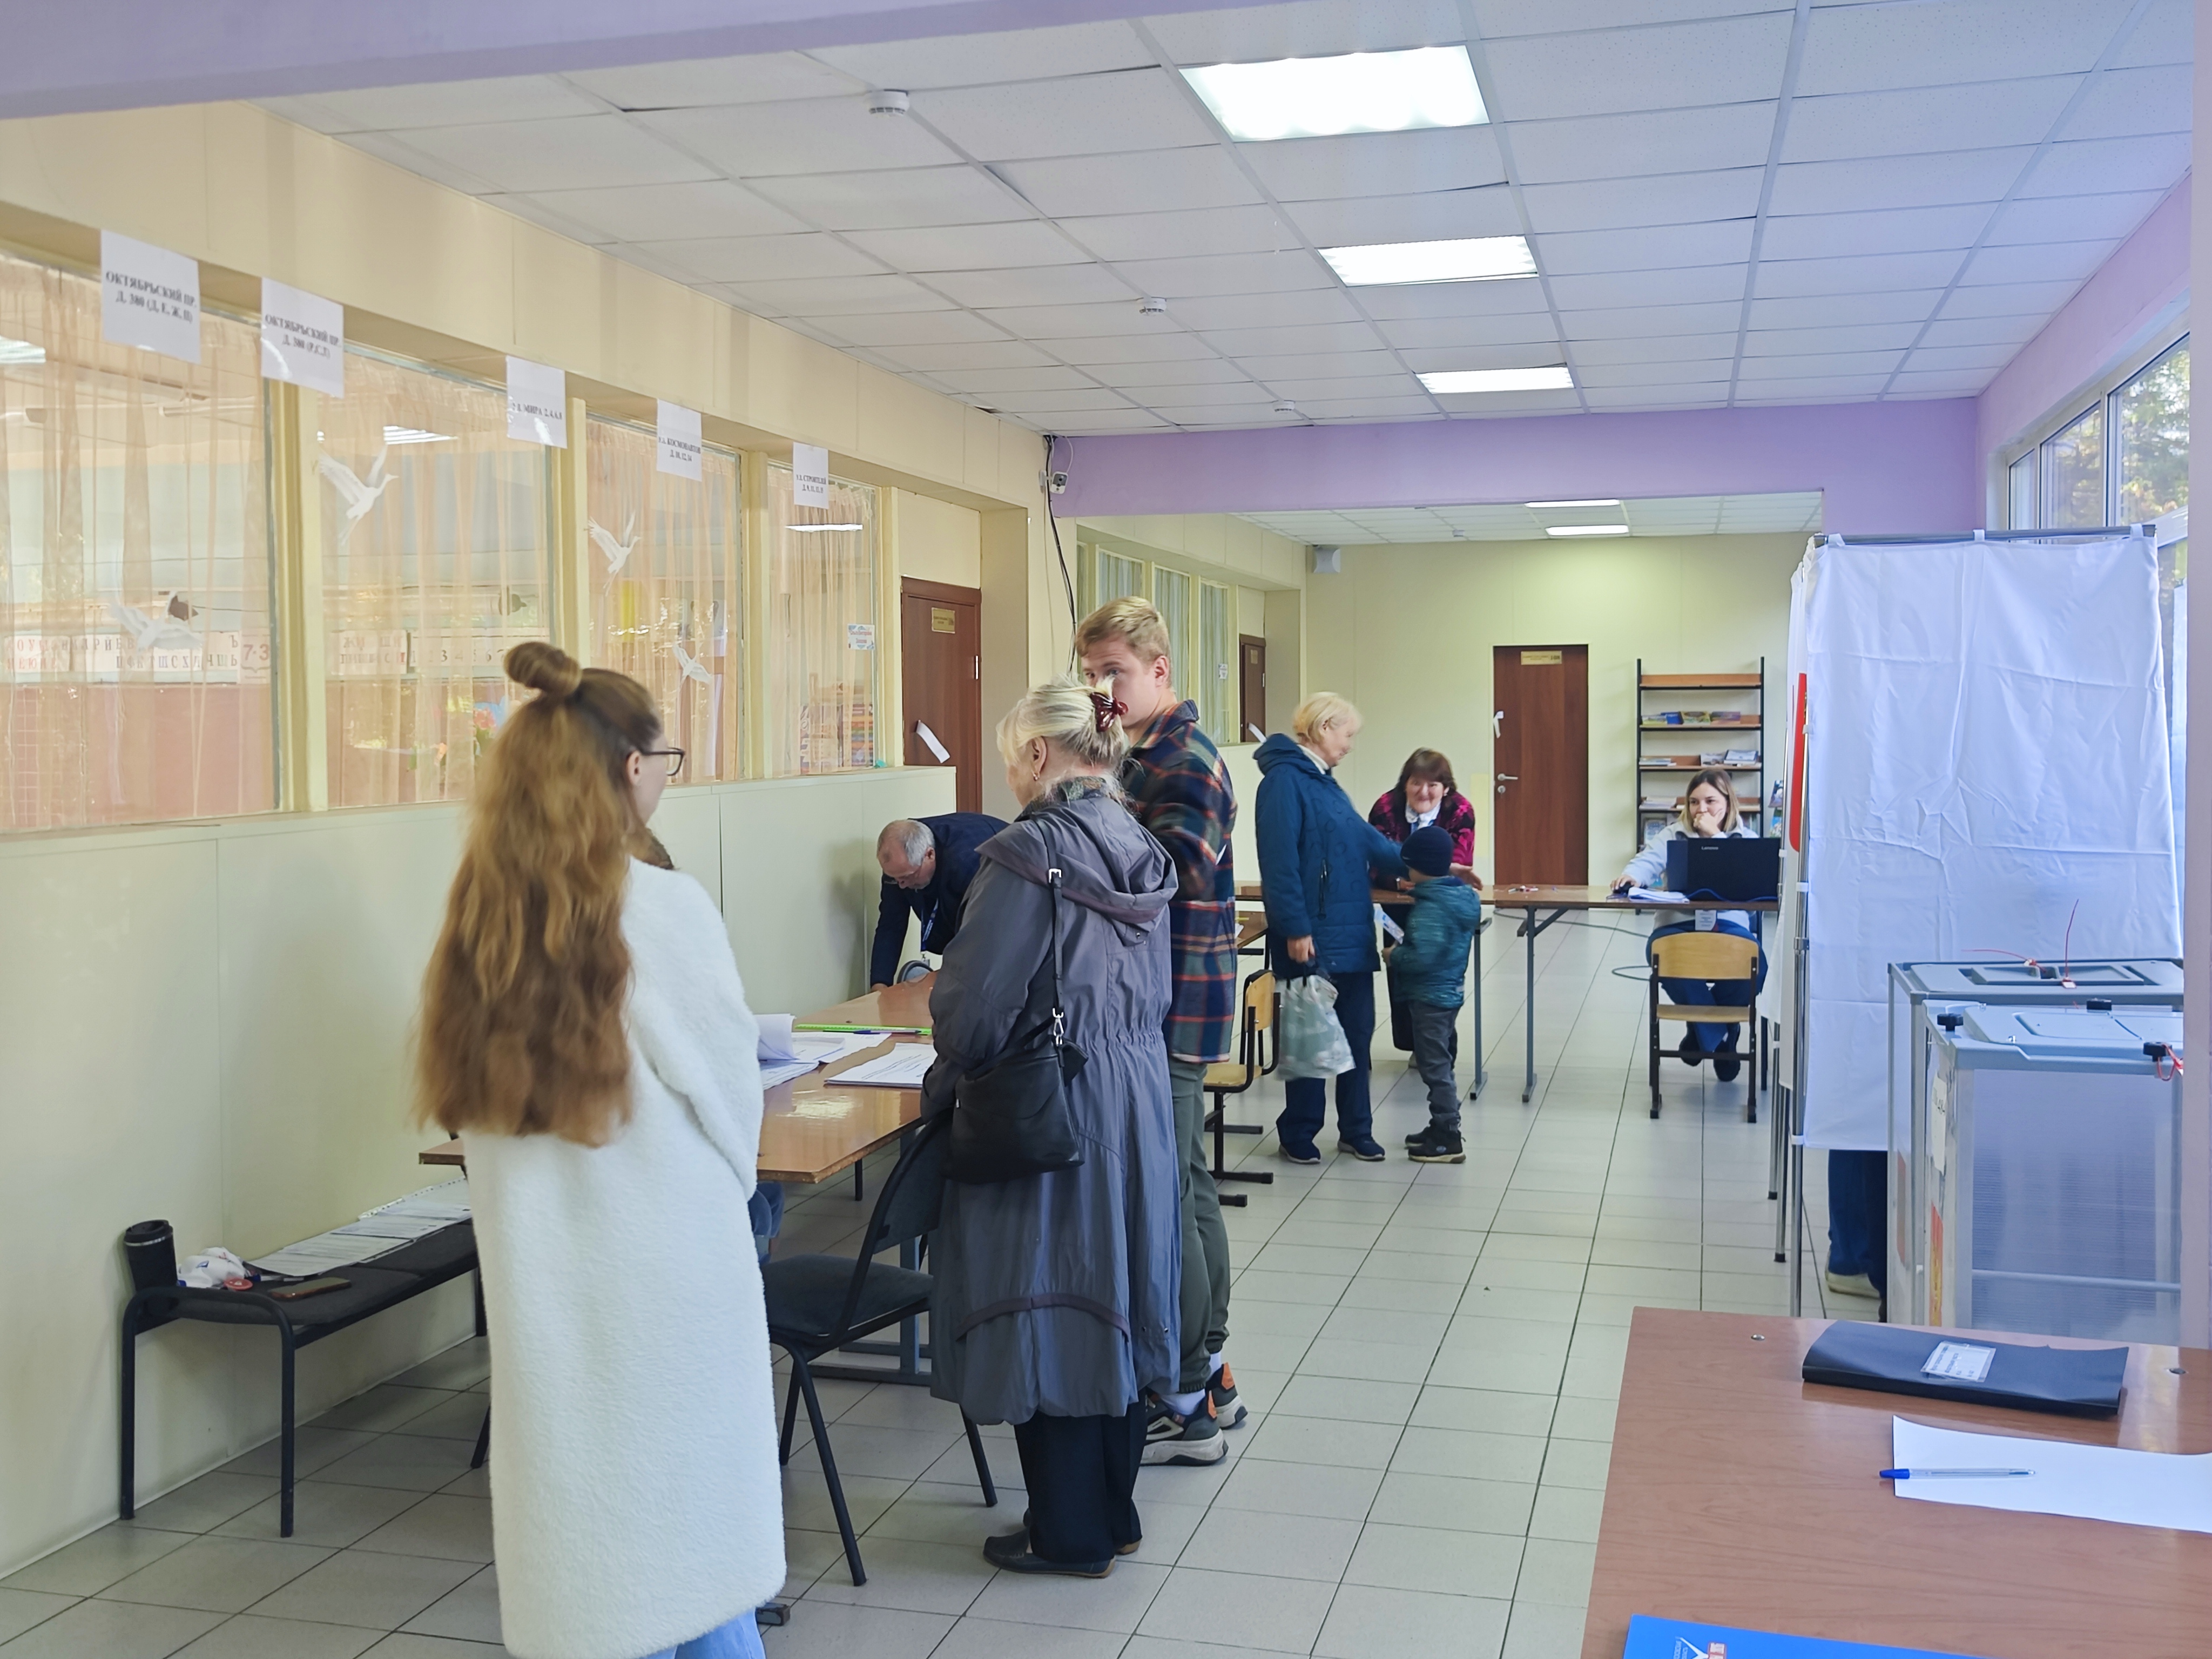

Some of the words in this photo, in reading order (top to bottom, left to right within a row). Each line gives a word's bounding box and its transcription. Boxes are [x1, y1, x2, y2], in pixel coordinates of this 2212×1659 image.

[106, 271, 182, 302] ОКТЯБРЬСКИЙ
[265, 314, 328, 342] ОКТЯБРЬСКИЙ
[524, 403, 543, 415] МИРА
[667, 437, 701, 454] КОСМОНАВТОВ
